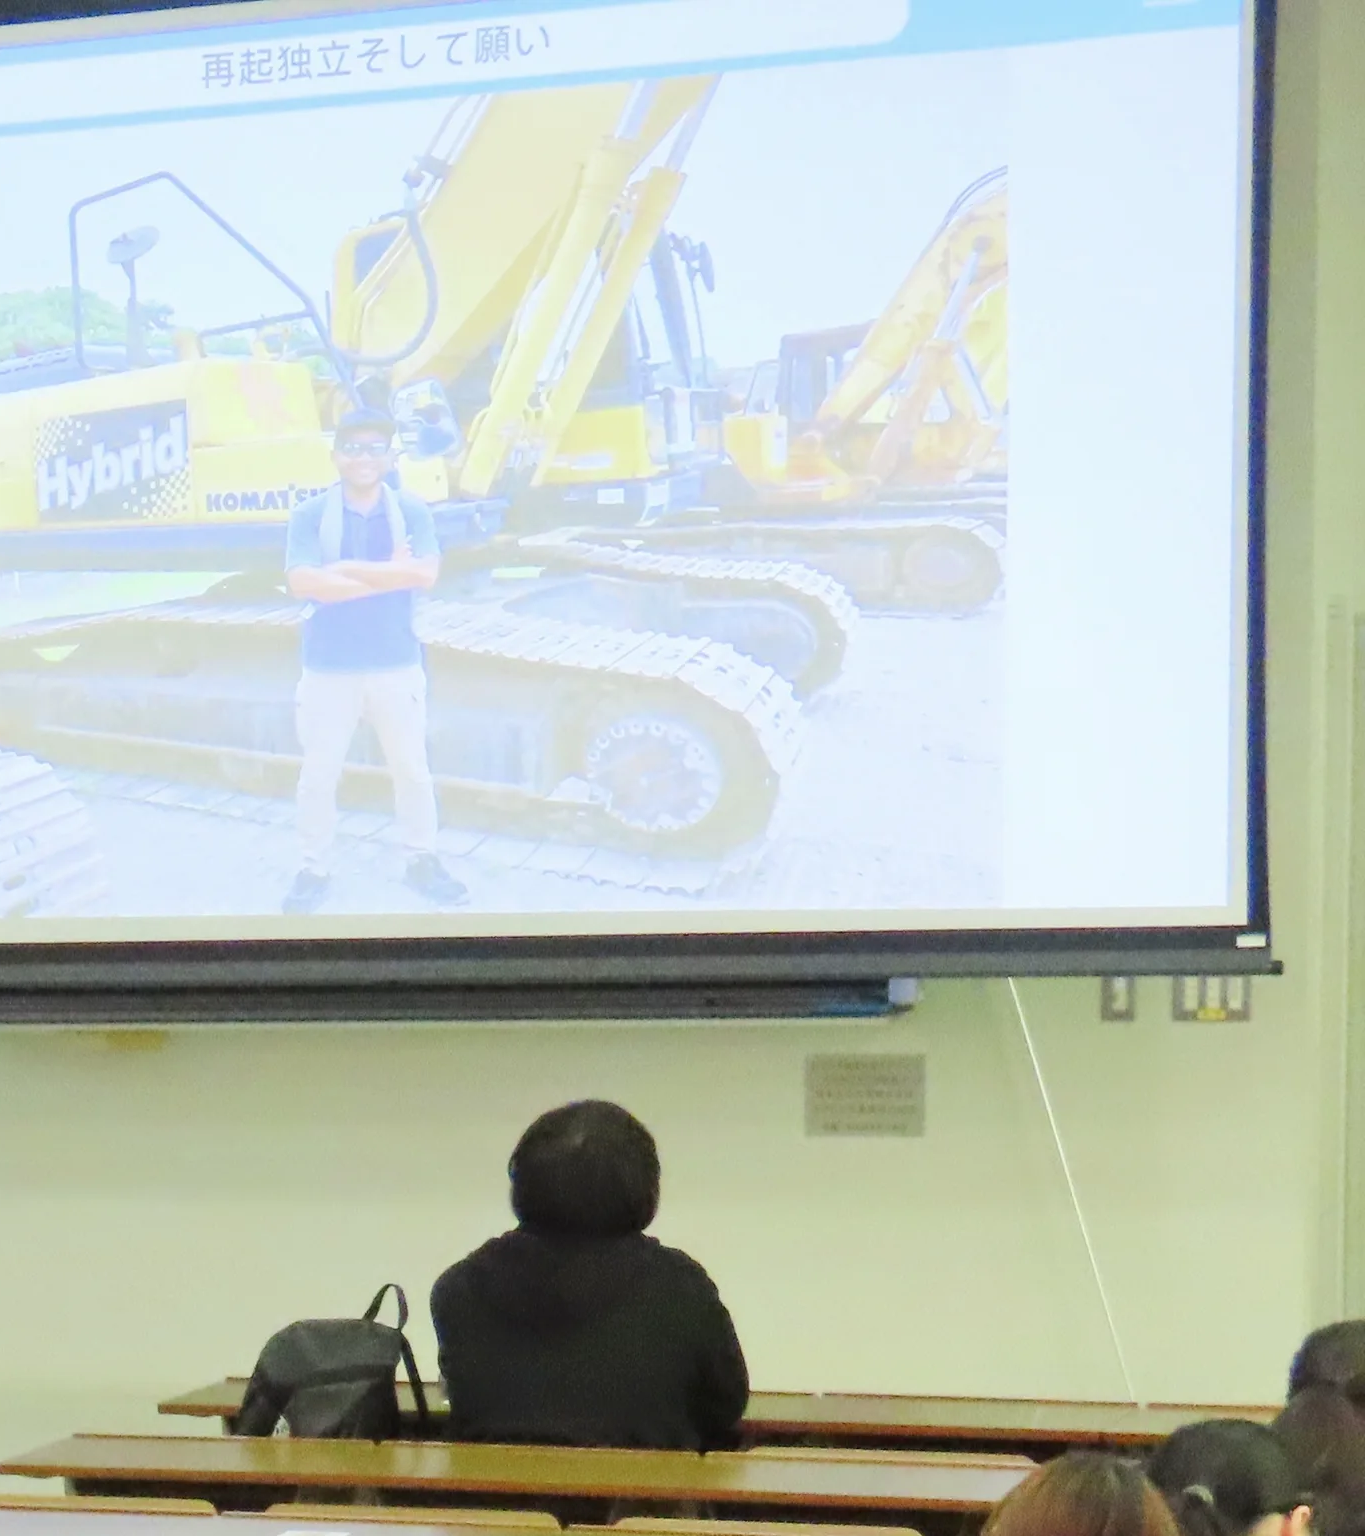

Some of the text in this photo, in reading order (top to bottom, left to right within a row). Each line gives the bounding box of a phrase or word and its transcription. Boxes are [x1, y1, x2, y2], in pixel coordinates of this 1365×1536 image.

[201, 25, 550, 89] 再起独立そして願い
[36, 411, 187, 512] Hybrid
